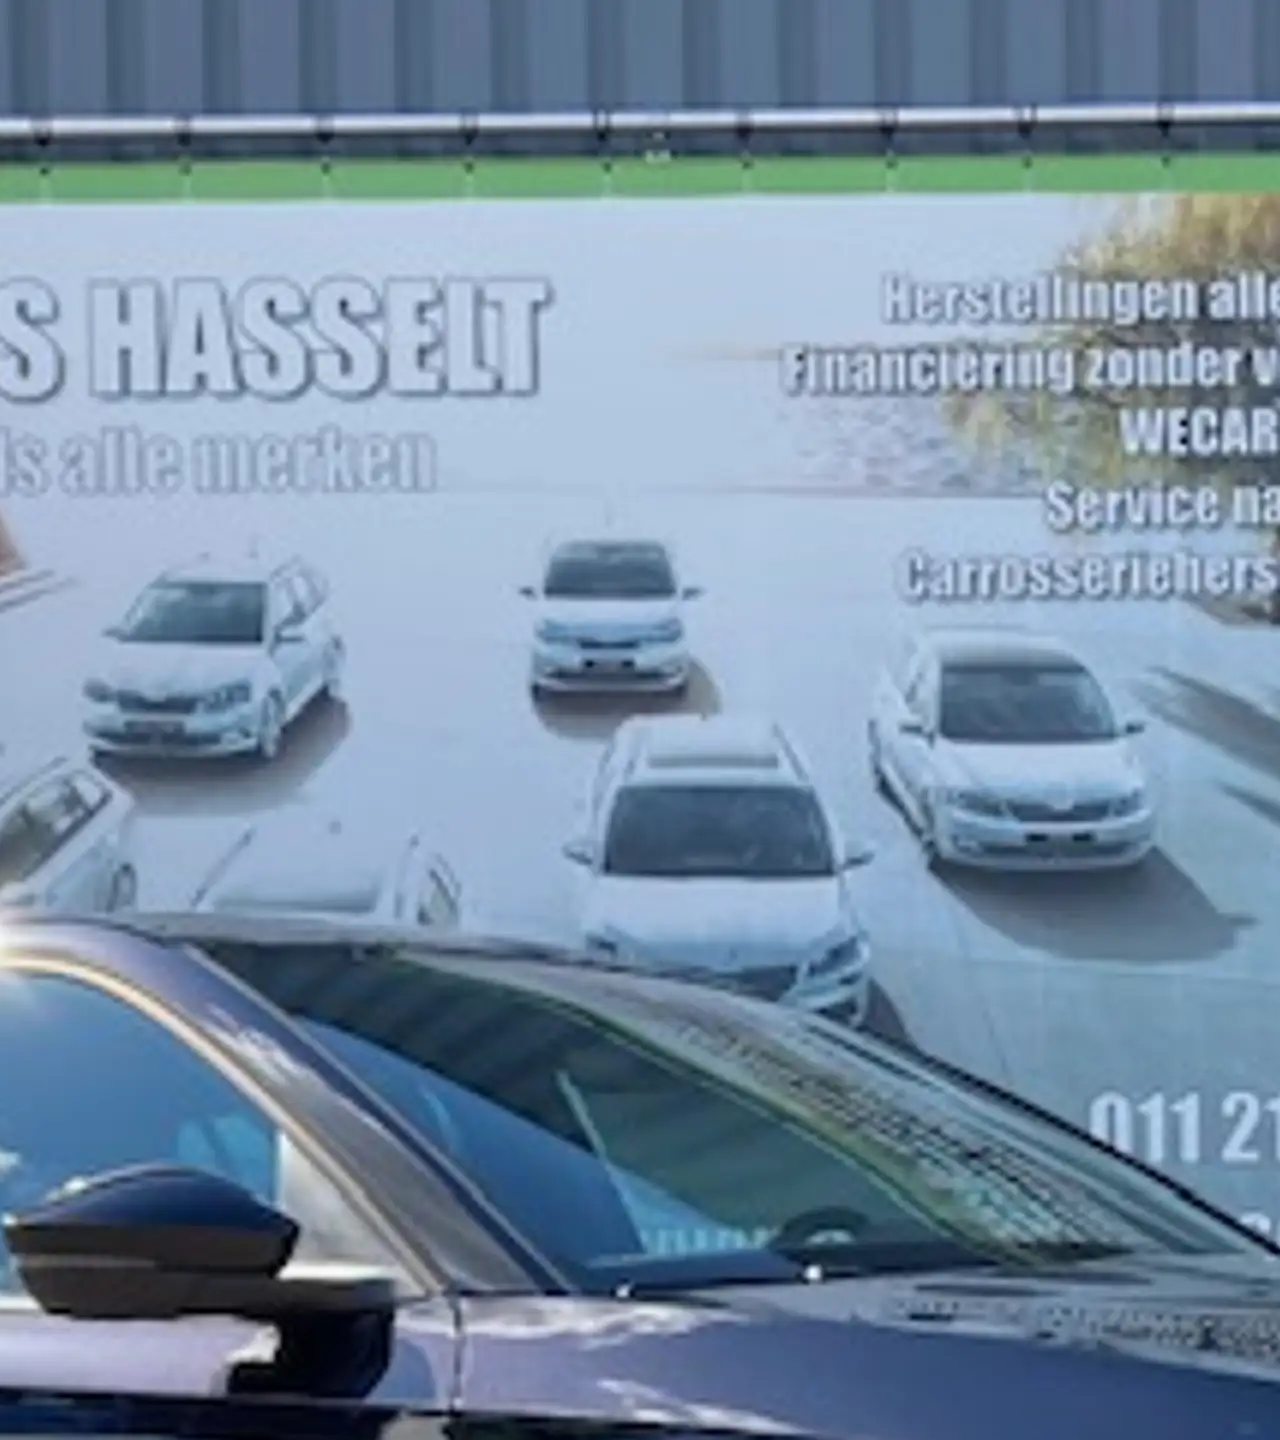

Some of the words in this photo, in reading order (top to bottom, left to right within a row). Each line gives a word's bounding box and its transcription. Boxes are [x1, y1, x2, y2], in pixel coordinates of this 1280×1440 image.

[882, 274, 1200, 326] Herstellingen
[88, 276, 552, 400] HASSELT
[782, 346, 1076, 396] Financiering
[1084, 342, 1240, 388] zonder
[62, 430, 180, 494] alle
[192, 432, 438, 494] merken
[1044, 484, 1220, 532] Service
[1089, 1090, 1201, 1164] 011
